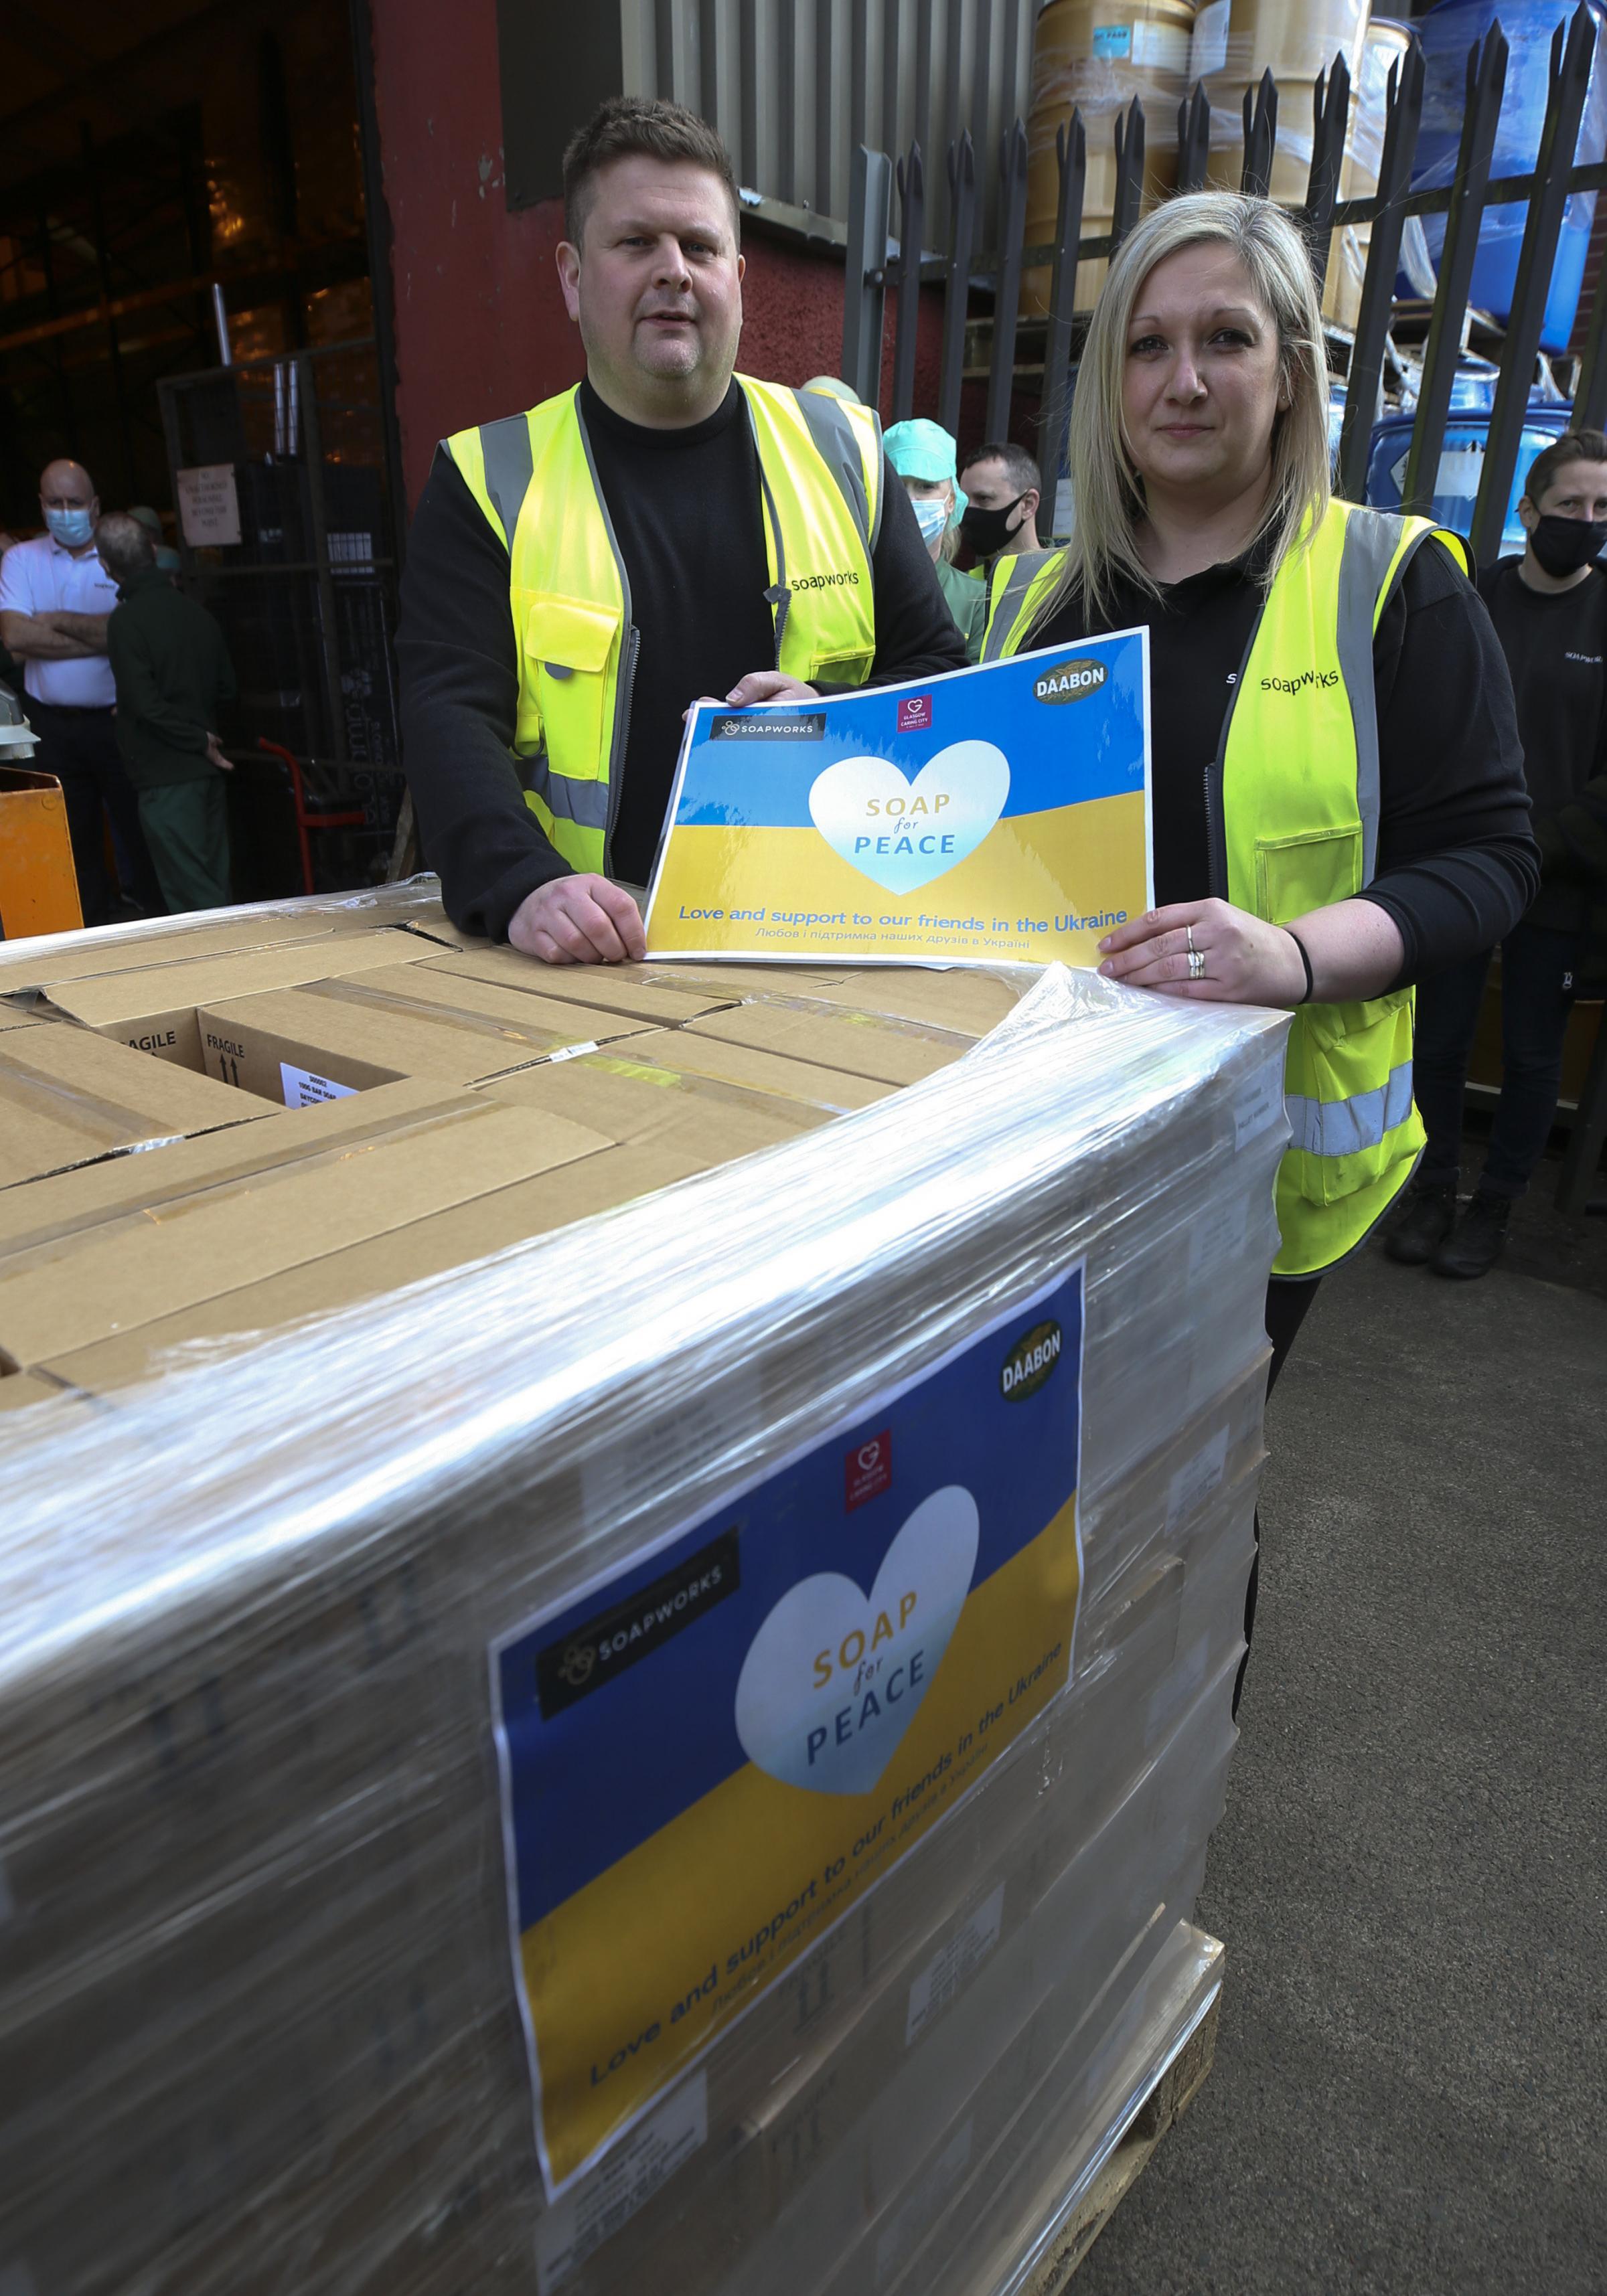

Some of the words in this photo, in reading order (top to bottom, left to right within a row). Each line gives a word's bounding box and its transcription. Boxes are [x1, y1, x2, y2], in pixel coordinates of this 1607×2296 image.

[791, 570, 859, 591] soapworks
[1036, 666, 1104, 698] DAABON
[741, 723, 814, 734] SOAPWORKS
[866, 794, 950, 817] SOAP
[894, 817, 919, 833] for
[854, 833, 955, 855] PEACE
[679, 906, 724, 920] Love
[730, 908, 765, 921] and
[771, 911, 846, 926] support
[852, 913, 872, 925] to
[878, 915, 912, 928] our
[918, 914, 984, 931] friends
[992, 918, 1009, 932] in
[1016, 917, 1049, 932] the
[1055, 910, 1127, 932] Ukraine
[755, 928, 799, 938] Любов
[811, 929, 876, 941] підтримка
[881, 932, 922, 941] наших
[926, 934, 968, 945] друзів
[207, 1034, 245, 1058] FRAGILE
[1002, 1328, 1061, 1394] DAABON
[599, 1565, 721, 1660] SOAPWORKS
[812, 1590, 917, 1690] SOAP
[853, 1656, 883, 1696] for
[807, 1649, 925, 1766] PEACE
[588, 2020, 662, 2088] Love
[670, 1965, 718, 2022] and
[726, 1880, 820, 1975] support
[824, 1857, 846, 1886] to
[852, 1817, 886, 1858] our
[892, 1750, 953, 1821] friends
[959, 1733, 973, 1756] in
[979, 1702, 1004, 1735] the
[1008, 1641, 1062, 1706] Ukraine
